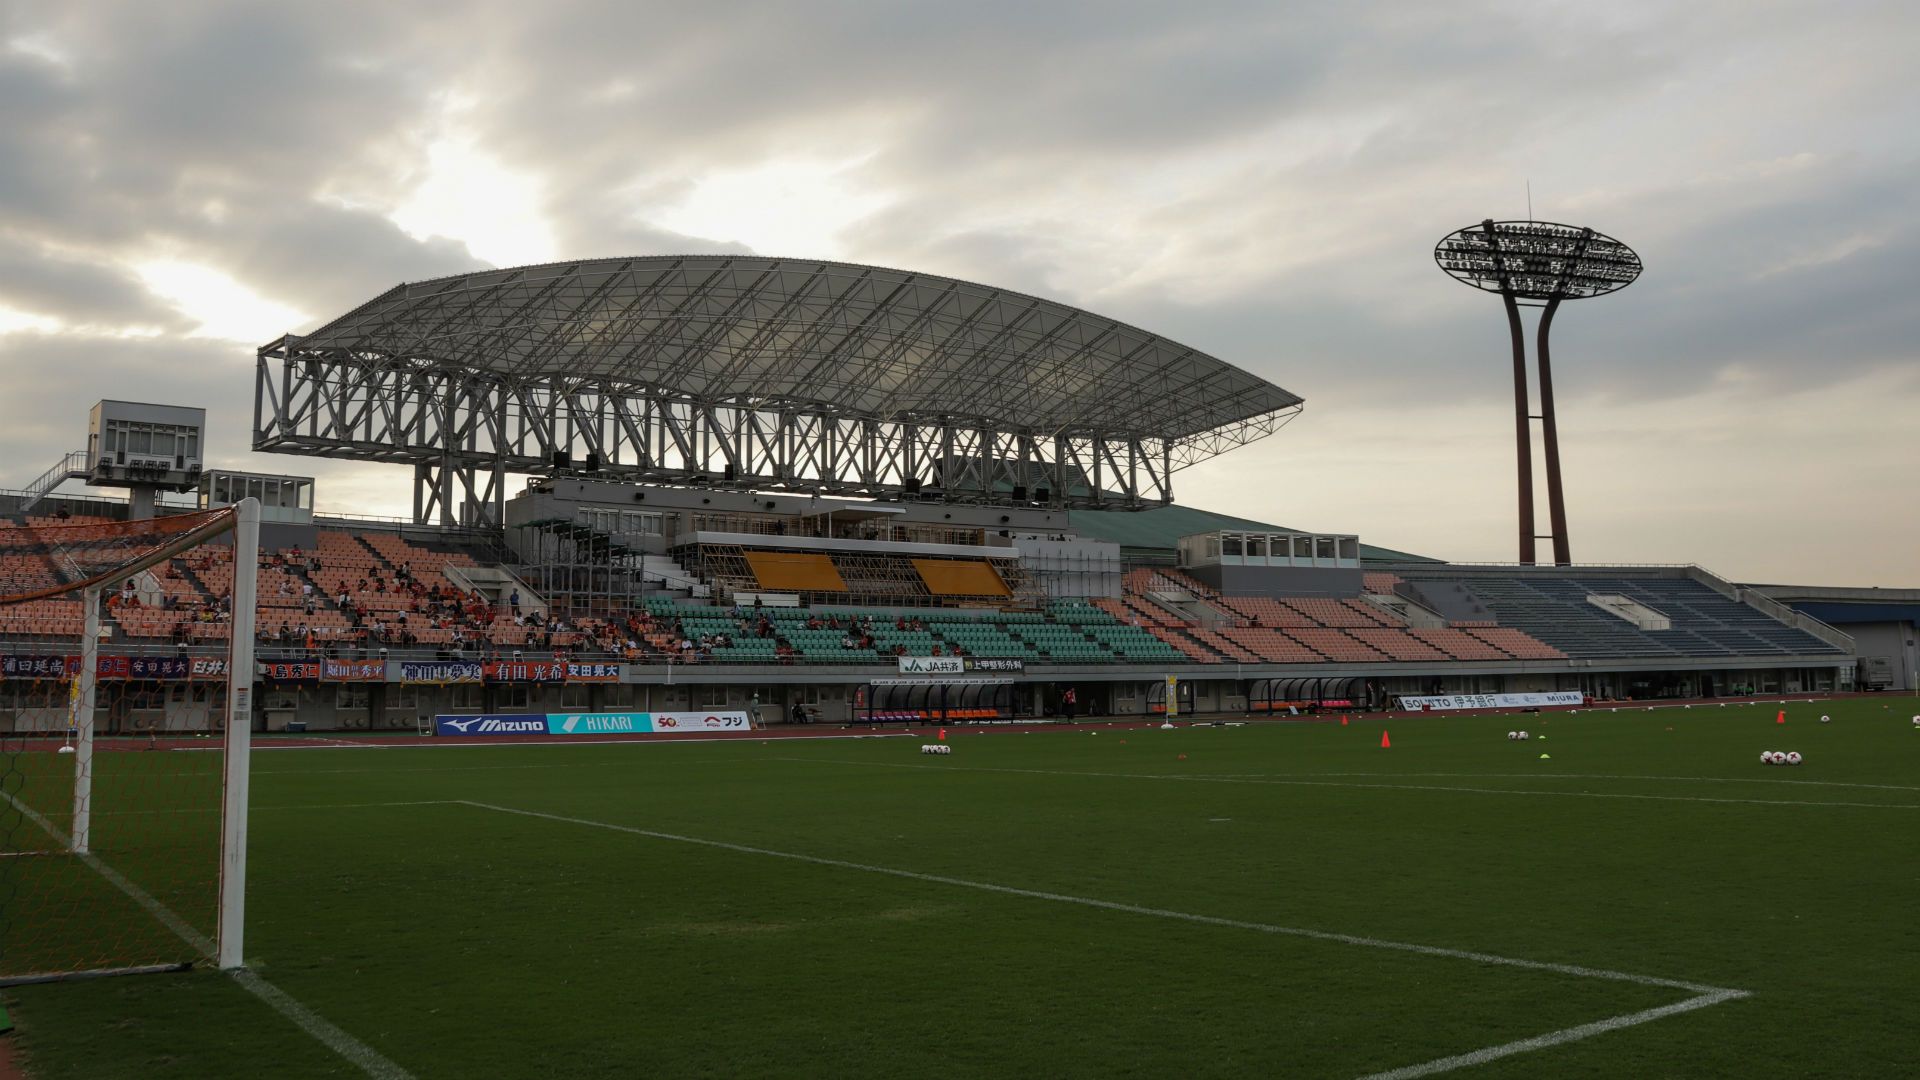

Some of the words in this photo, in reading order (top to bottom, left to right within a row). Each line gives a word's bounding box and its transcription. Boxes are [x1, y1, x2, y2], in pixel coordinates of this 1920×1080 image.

[70, 659, 126, 672] 小秀仁
[133, 661, 187, 673] 安田晃大
[568, 664, 618, 677] 安田晃大
[925, 661, 959, 671] JA共済
[1547, 694, 1580, 703] MIURA
[586, 716, 633, 730] HIKARI
[722, 717, 743, 726] フジ
